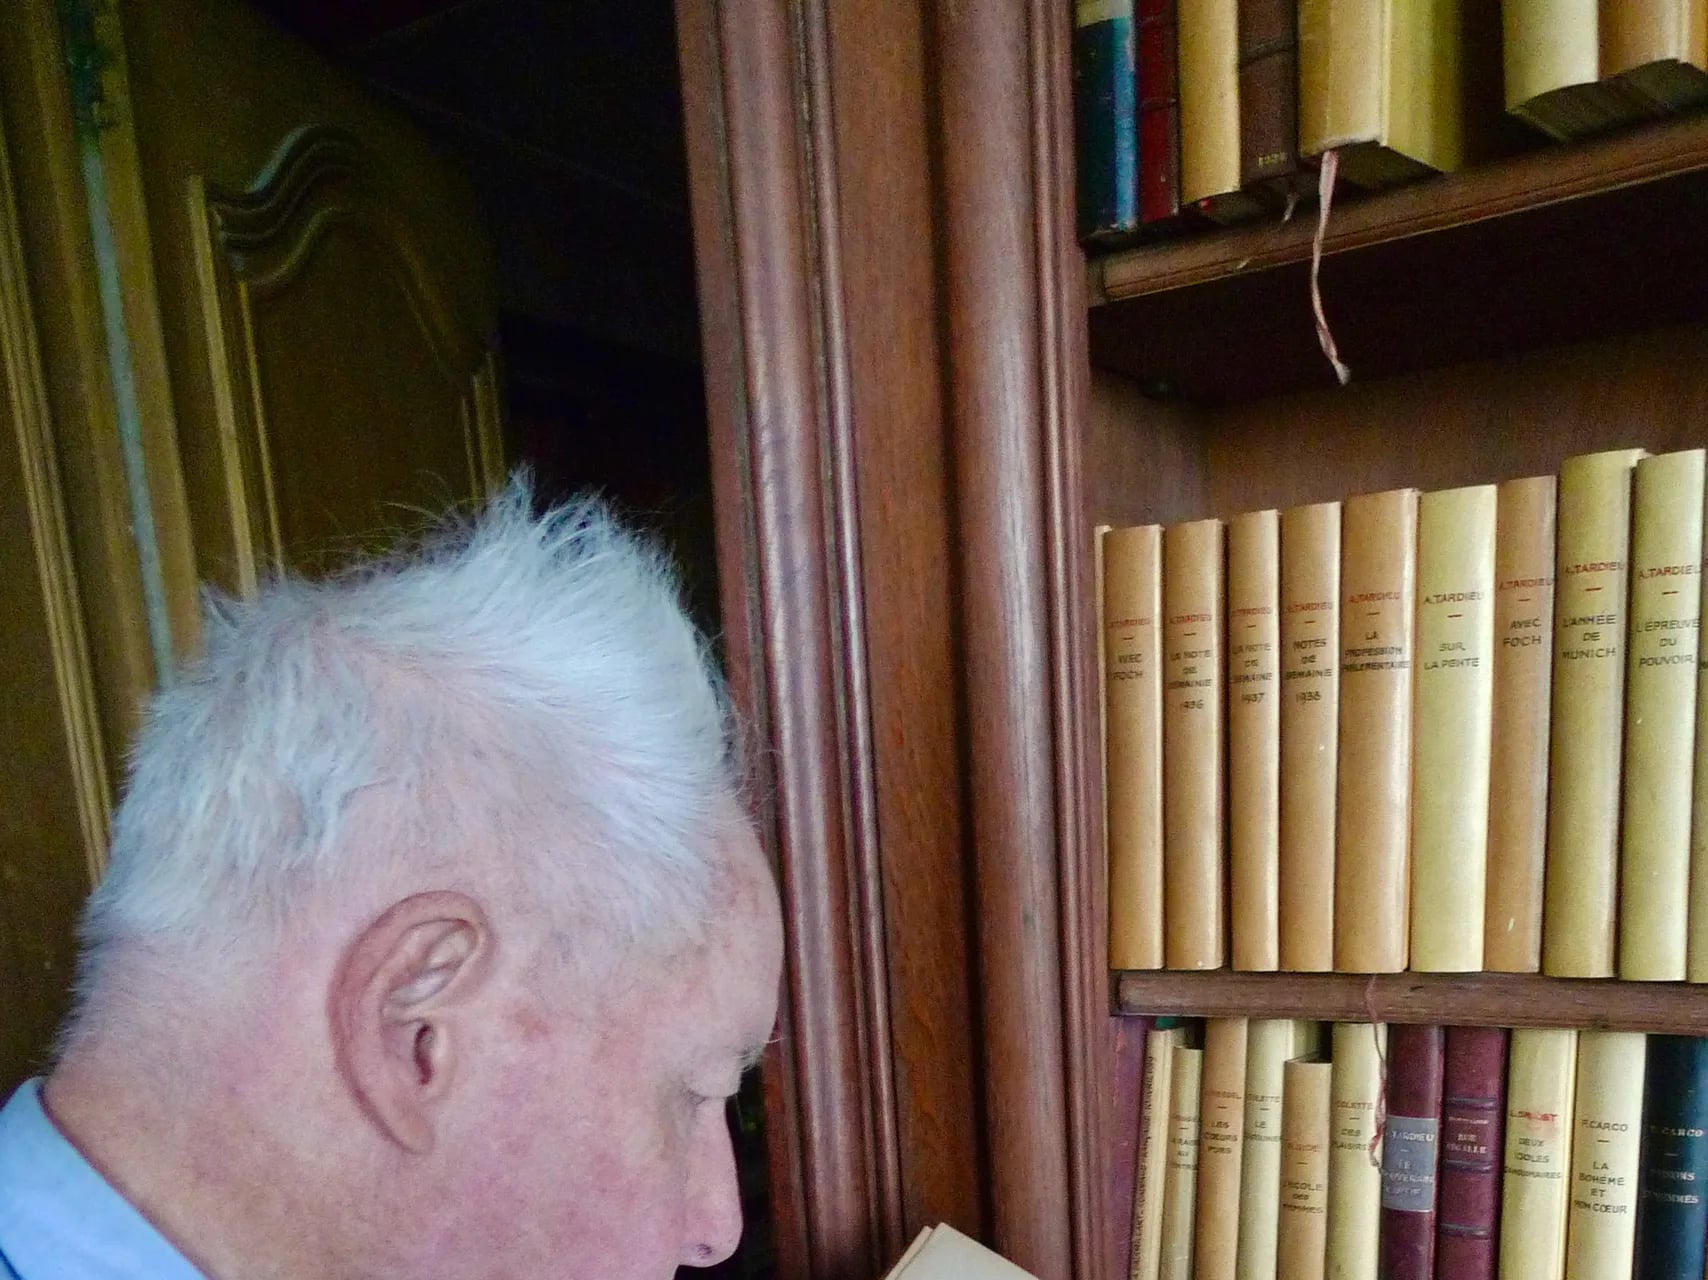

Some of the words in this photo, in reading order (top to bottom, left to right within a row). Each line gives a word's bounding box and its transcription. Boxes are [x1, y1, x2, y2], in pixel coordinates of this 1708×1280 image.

[1509, 617, 1543, 631] AVEC
[1364, 631, 1380, 641] LA
[1503, 635, 1543, 649] FOCH
[1581, 631, 1602, 643] DE
[1244, 642, 1272, 653] NOTE
[1292, 637, 1328, 651] NOTES
[1438, 640, 1467, 653] SUR
[1657, 637, 1677, 649] DU
[1182, 648, 1213, 659] NOTE
[1344, 645, 1403, 658] PROFESSION
[1561, 647, 1617, 661] MUNICH
[1423, 660, 1441, 671] LA
[1441, 657, 1481, 670] PENTE
[1638, 652, 1697, 669] POUVOIR
[1112, 669, 1144, 682] FOCH
[1660, 1125, 1705, 1139] CARCO
[1517, 1136, 1545, 1148] DEUX
[1513, 1151, 1551, 1164] IDOLES
[1592, 1160, 1610, 1171] LA
[1589, 1187, 1606, 1199] ET
